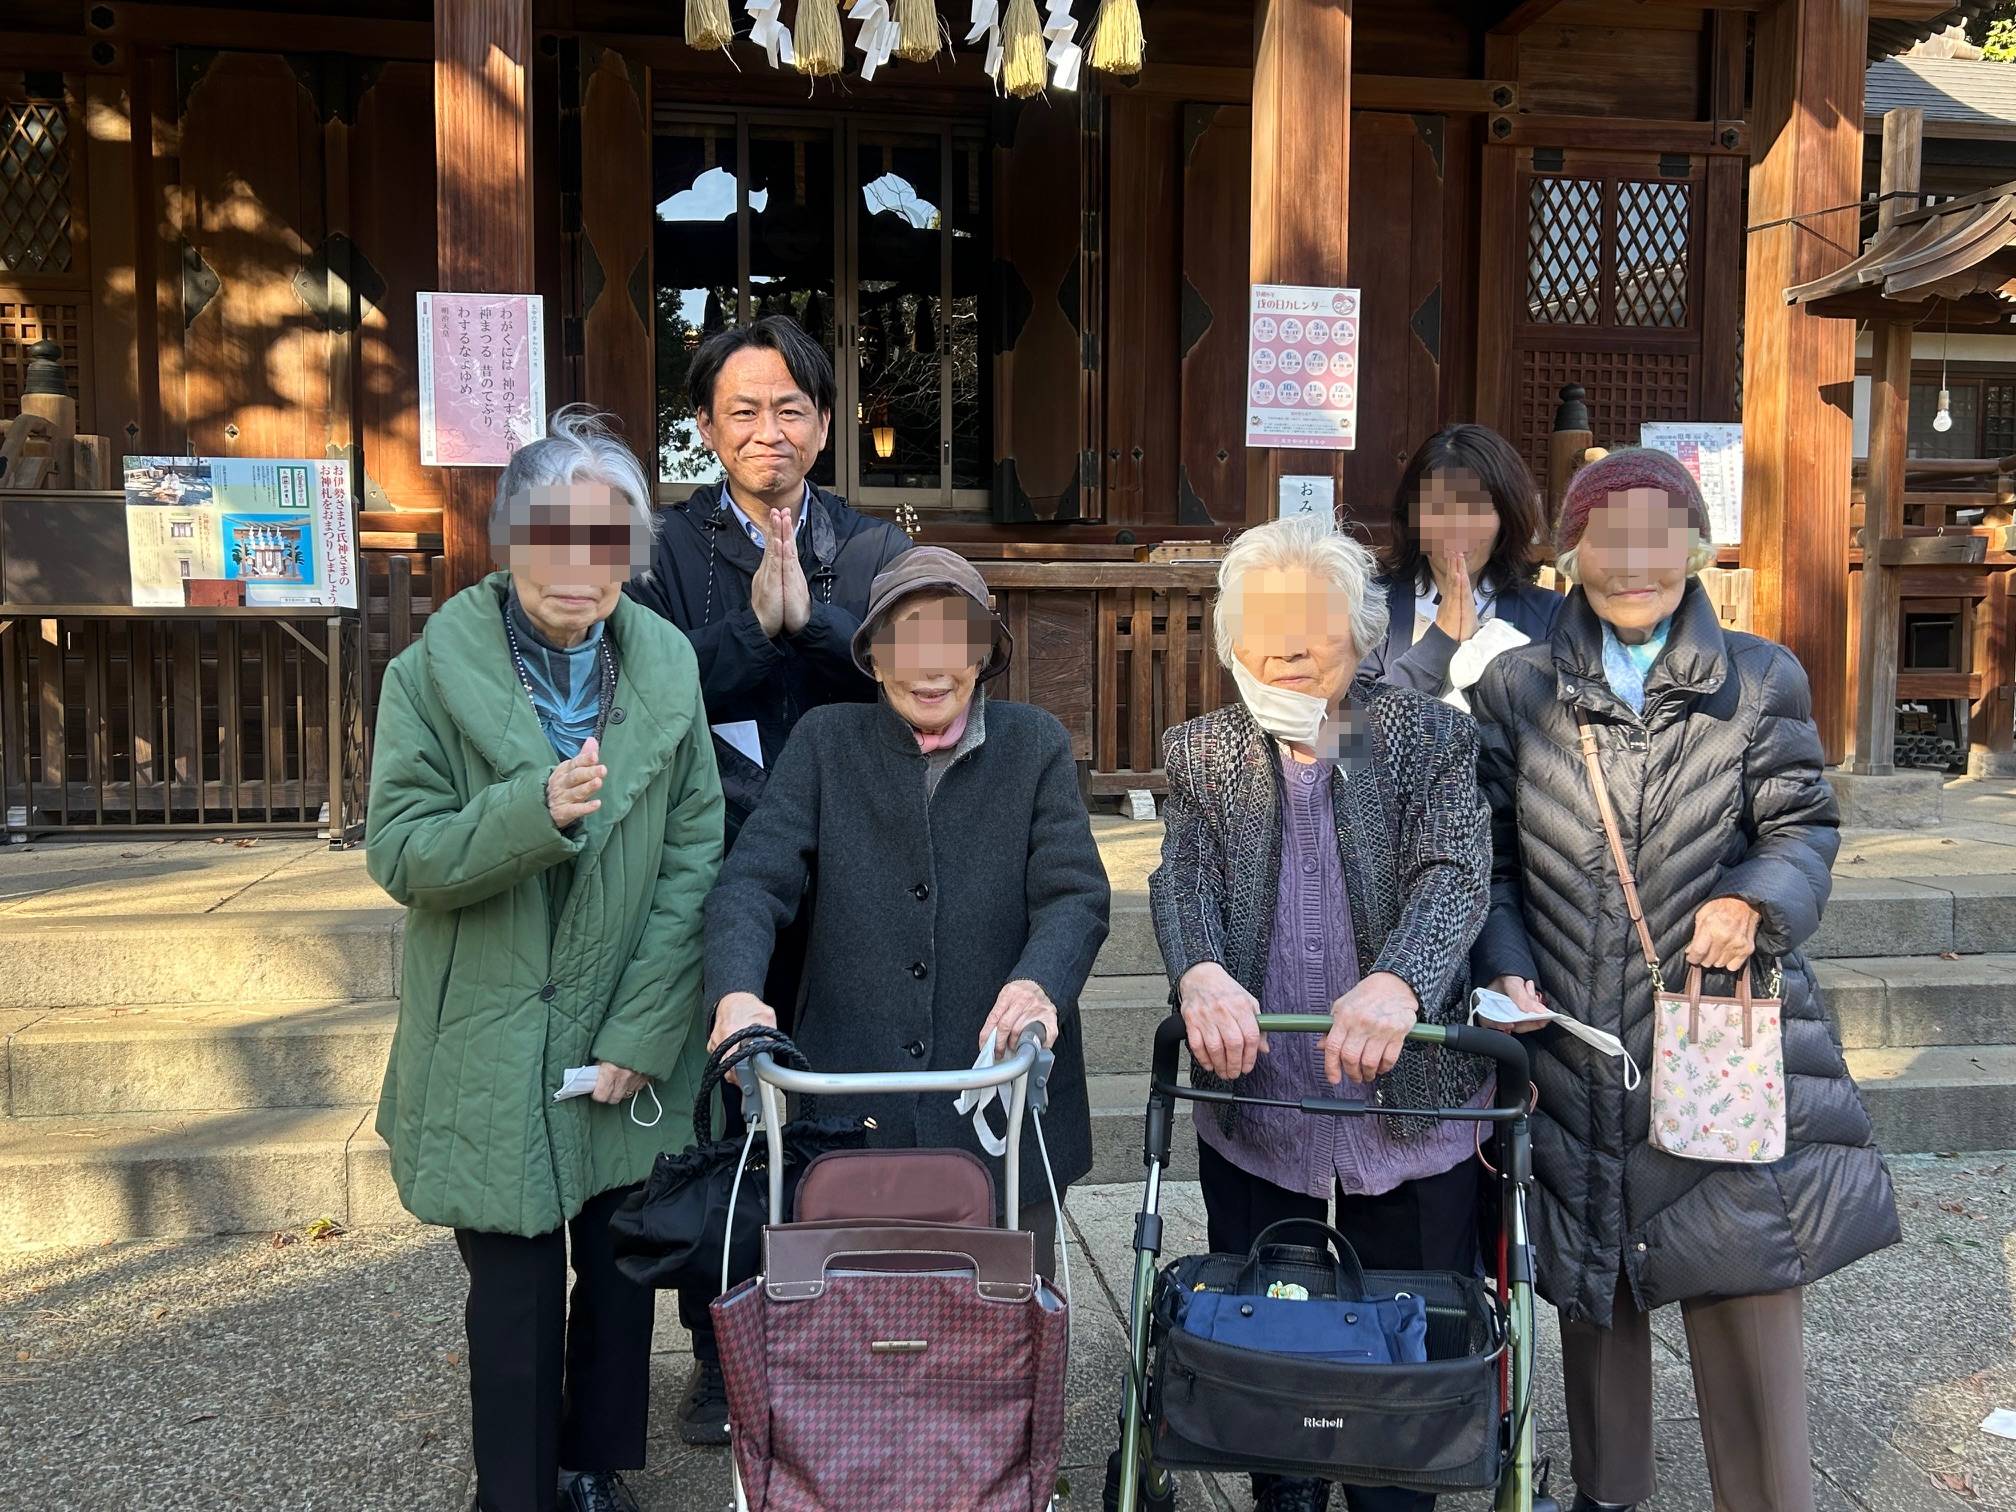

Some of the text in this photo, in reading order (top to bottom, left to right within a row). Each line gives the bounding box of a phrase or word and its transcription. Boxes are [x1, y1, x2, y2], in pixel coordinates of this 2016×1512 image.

[440, 306, 450, 338] 明治天皇
[500, 308, 514, 371] わがくには
[1257, 299, 1329, 311] 戌の日カレンダー
[458, 307, 473, 395] わするなよゆめ
[479, 306, 495, 428] 神まつる 昔のてぶり
[333, 465, 350, 586] お伊勢さまと氏神さまの
